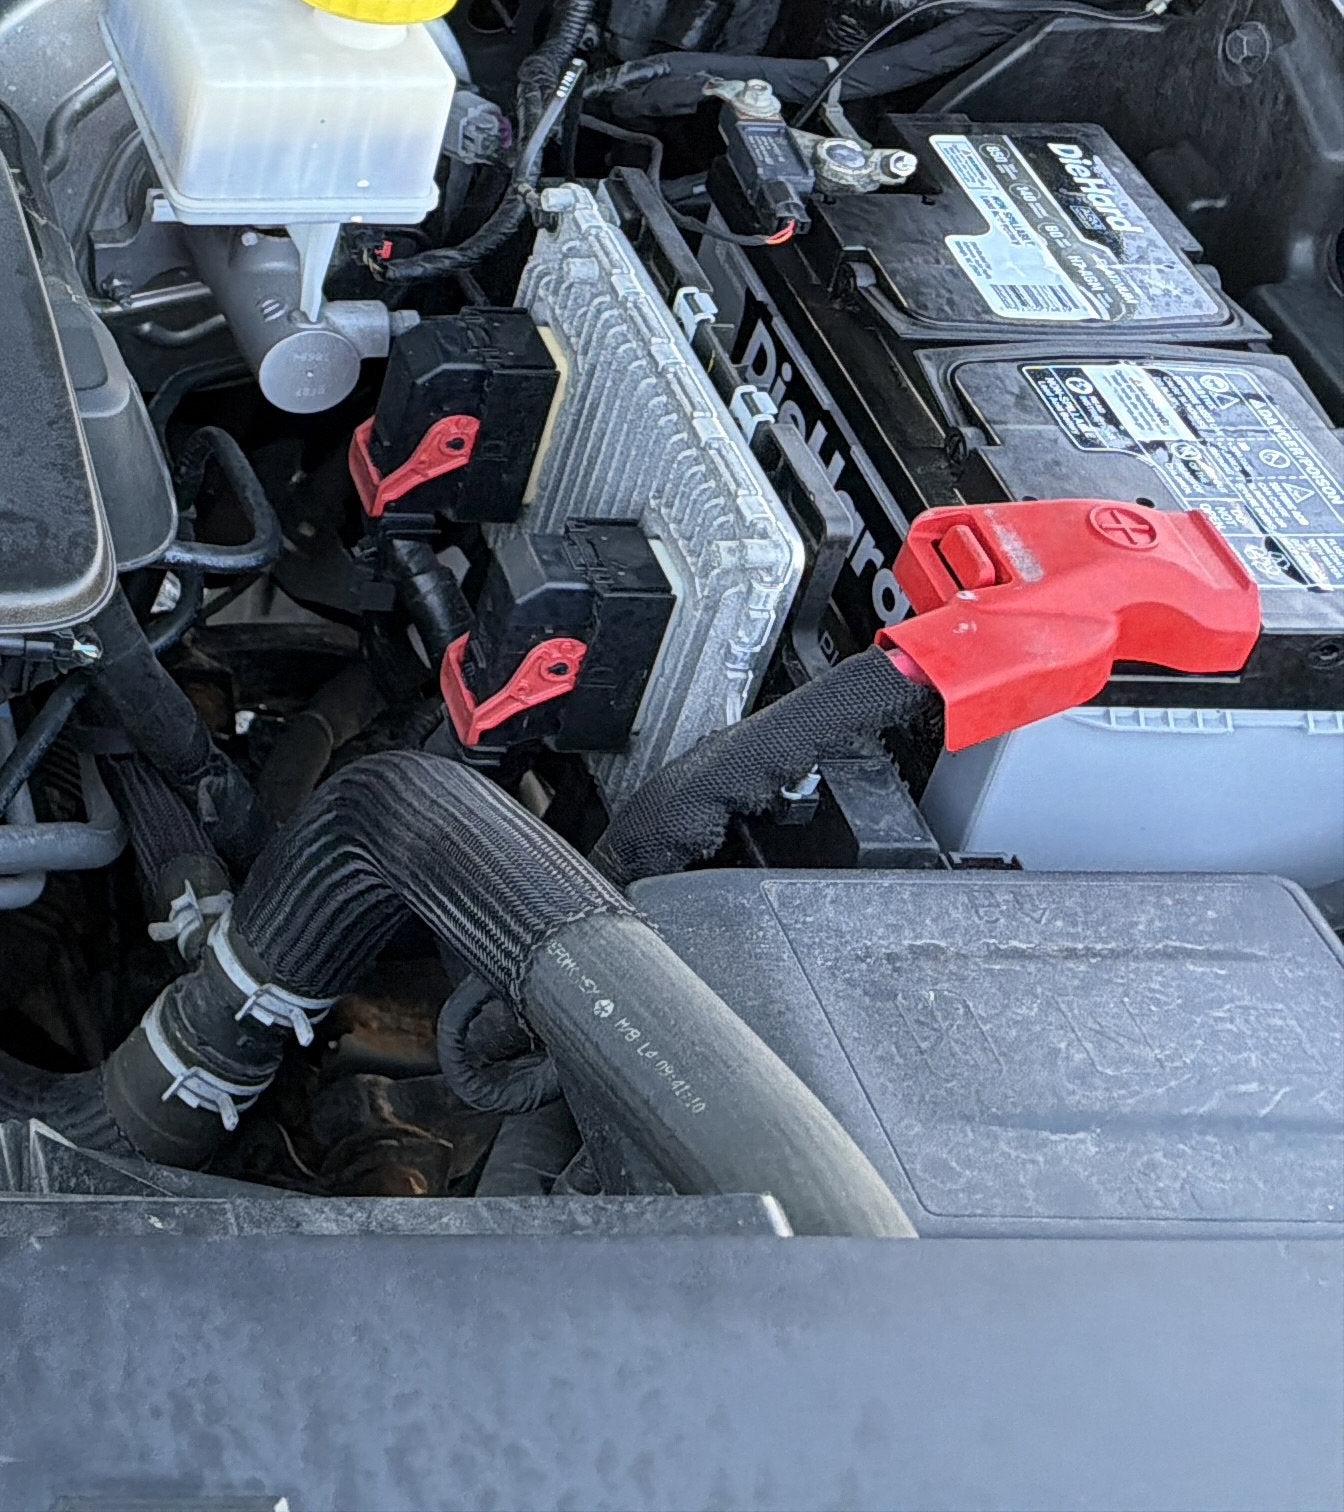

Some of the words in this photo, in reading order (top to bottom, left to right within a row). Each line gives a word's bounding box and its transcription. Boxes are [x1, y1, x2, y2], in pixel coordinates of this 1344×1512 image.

[985, 145, 1008, 163] 850
[1046, 143, 1144, 233] DieHard
[1067, 255, 1104, 291] H7-AGM
[1213, 507, 1238, 526] NOT
